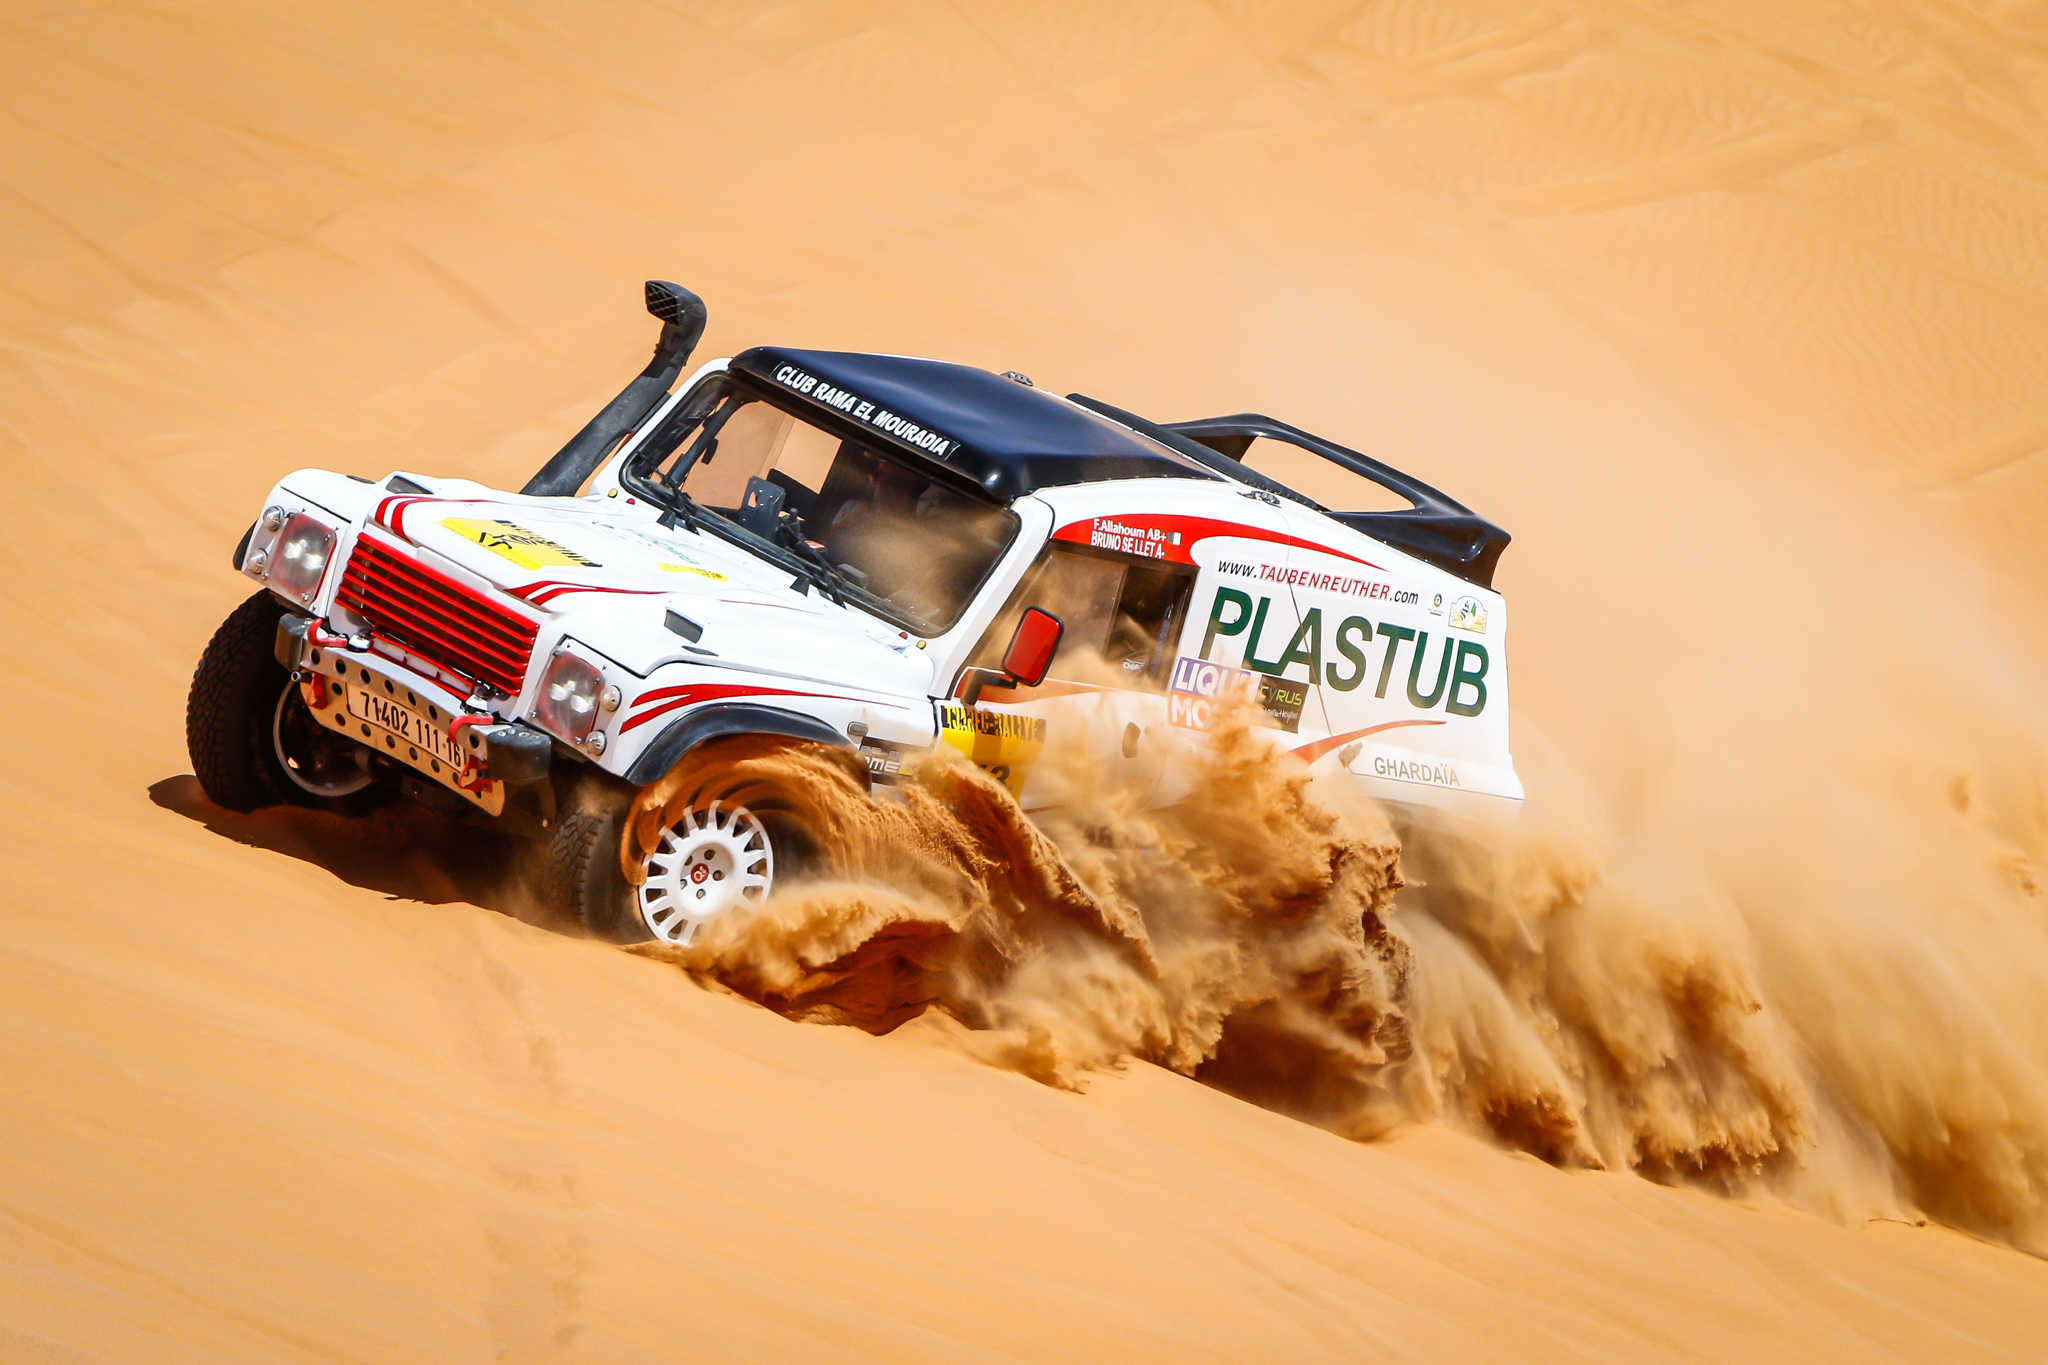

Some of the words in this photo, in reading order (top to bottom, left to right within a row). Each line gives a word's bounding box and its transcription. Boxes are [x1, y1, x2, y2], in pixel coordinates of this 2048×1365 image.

[776, 365, 818, 393] CLUB
[812, 382, 858, 412] RAMA
[853, 402, 876, 421] EL
[872, 410, 950, 456] MOURADIA
[1091, 531, 1121, 551] BRUNO
[1093, 518, 1145, 538] F.Allahoum
[1147, 528, 1167, 542] AB+
[1218, 559, 1419, 605] www.TAUBENREUTHER.com
[1198, 585, 1489, 718] PLASTUB
[360, 691, 409, 736] 71402
[416, 718, 440, 754] 111
[446, 736, 462, 767] 16
[1374, 757, 1461, 787] GHARDAÏA
